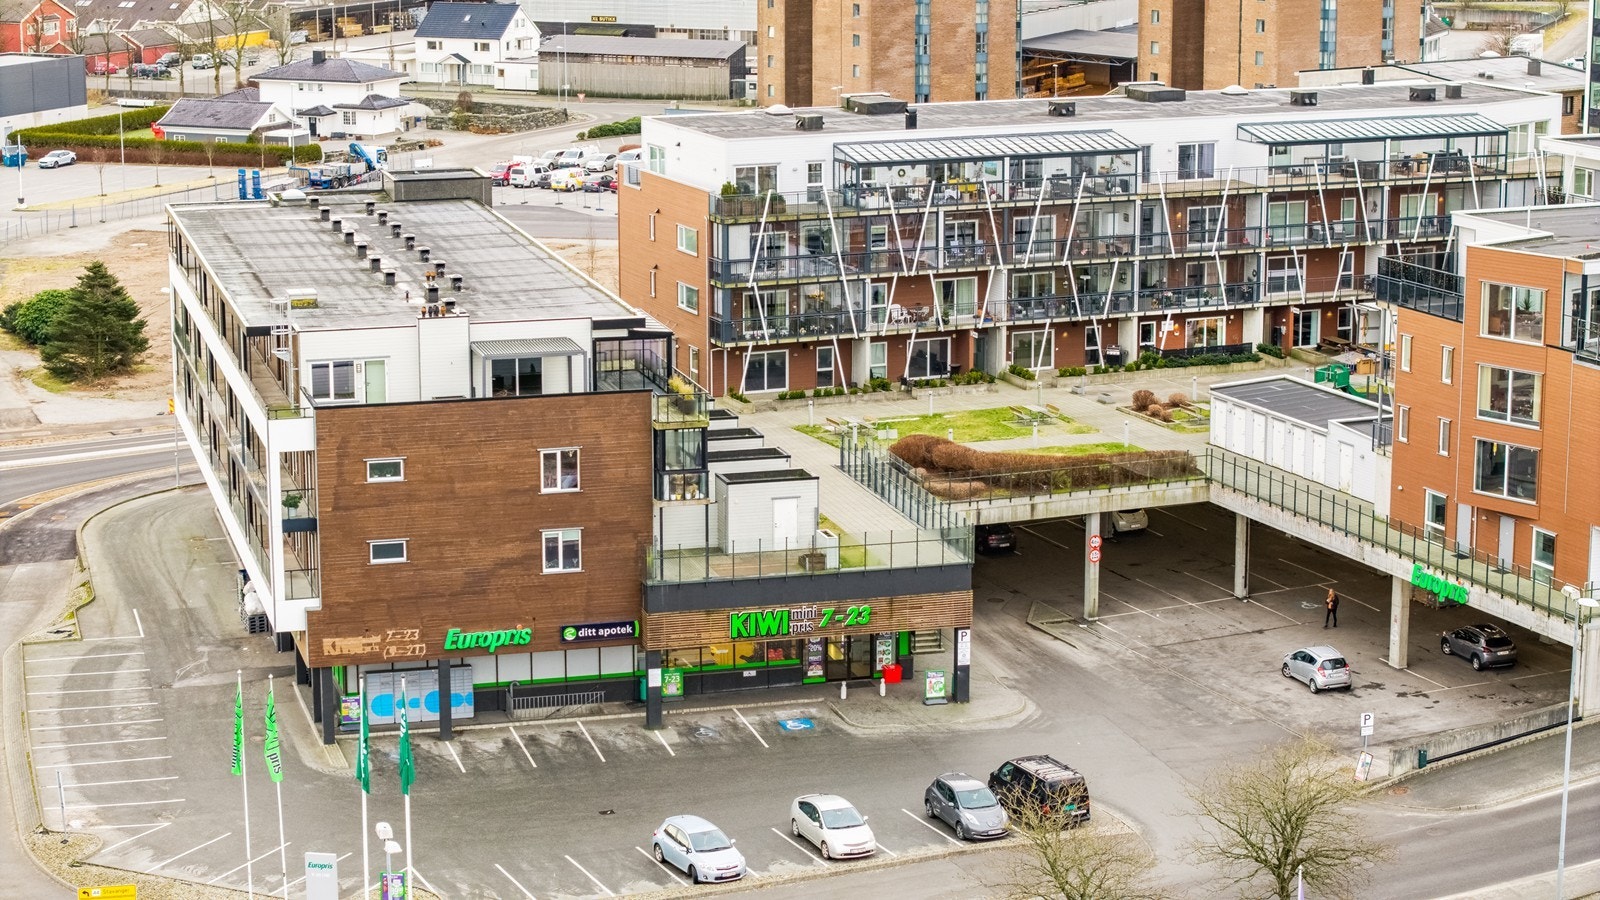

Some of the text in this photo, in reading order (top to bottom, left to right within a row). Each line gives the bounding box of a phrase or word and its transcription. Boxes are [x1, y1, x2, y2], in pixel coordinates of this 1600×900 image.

[1411, 563, 1469, 604] Europris
[730, 605, 817, 639] KIWI mini
[790, 619, 814, 635] pris
[578, 624, 633, 637] ditt apotek
[961, 632, 967, 641] P
[444, 625, 532, 652] Europris
[664, 675, 680, 683] 7-23
[1364, 714, 1371, 725] P
[267, 752, 282, 774] pris
[308, 861, 333, 870] Europris
